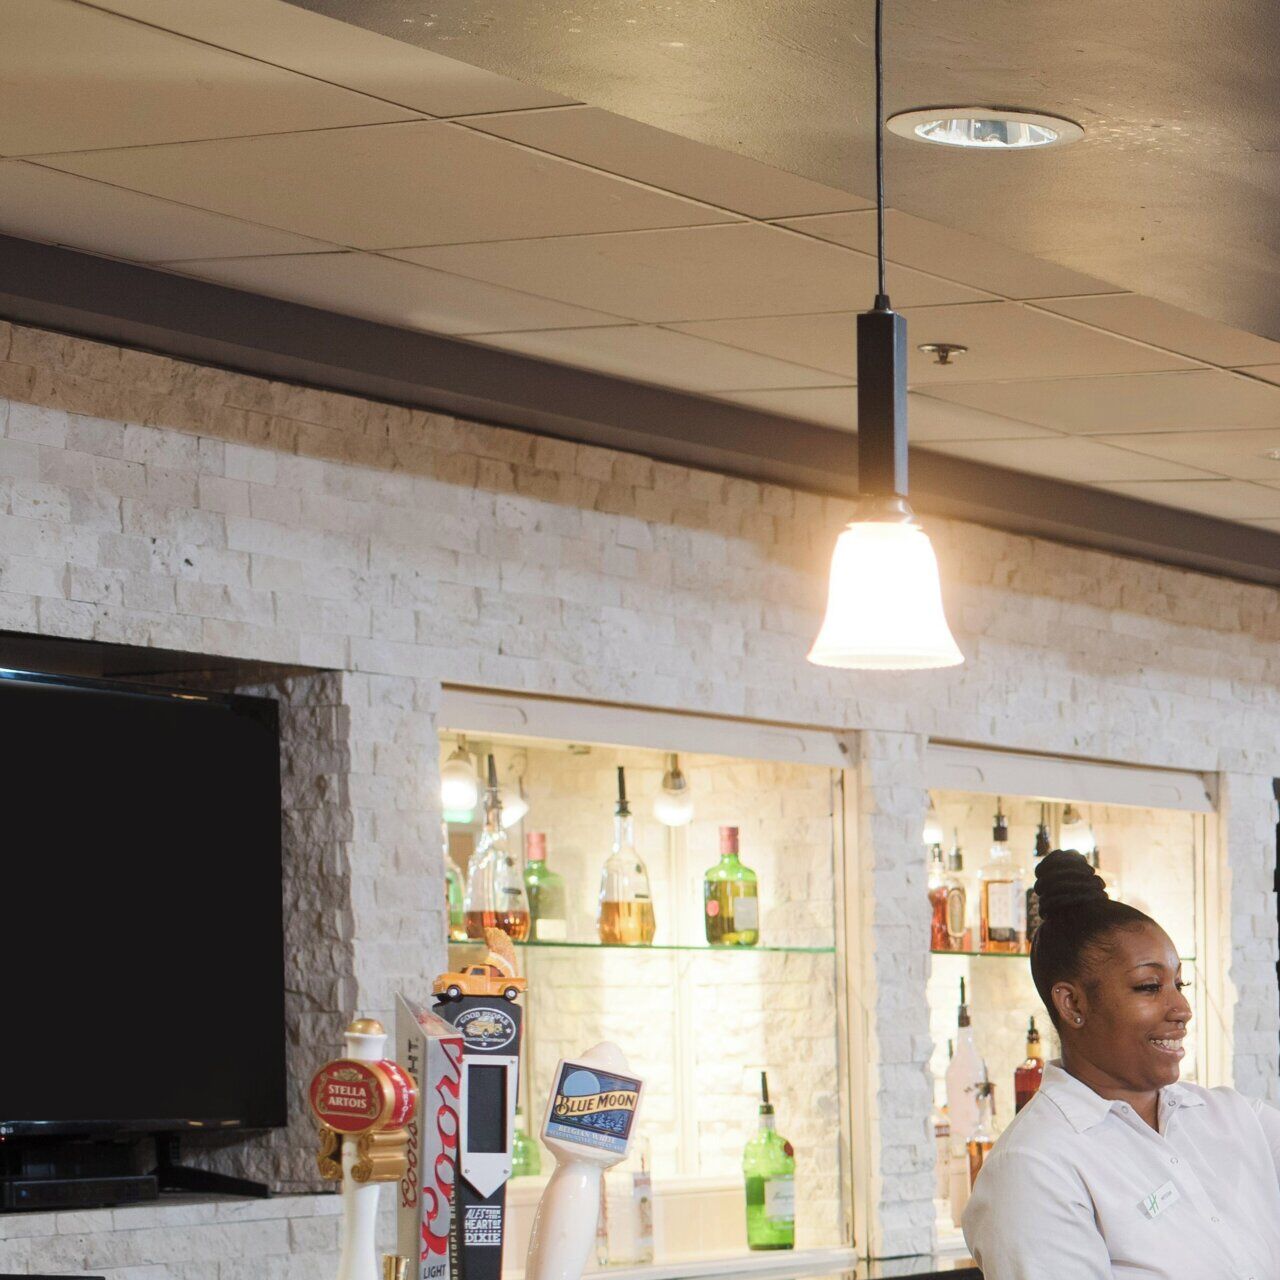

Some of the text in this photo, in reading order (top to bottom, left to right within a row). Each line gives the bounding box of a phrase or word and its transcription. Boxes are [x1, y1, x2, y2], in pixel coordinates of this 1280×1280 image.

[460, 1011, 510, 1026] GOOD PEOPLE
[328, 1084, 367, 1097] STELLA
[327, 1096, 367, 1109] ARTOIS
[554, 1094, 636, 1117] BLUE MOON
[558, 1126, 592, 1138] BELGIAN
[420, 1038, 464, 1263] Coors
[465, 1209, 486, 1219] ALES
[465, 1219, 492, 1229] HEART
[450, 1224, 458, 1264] PEOPLE
[465, 1233, 501, 1243] DIXIE
[423, 1264, 446, 1279] LIGHT
